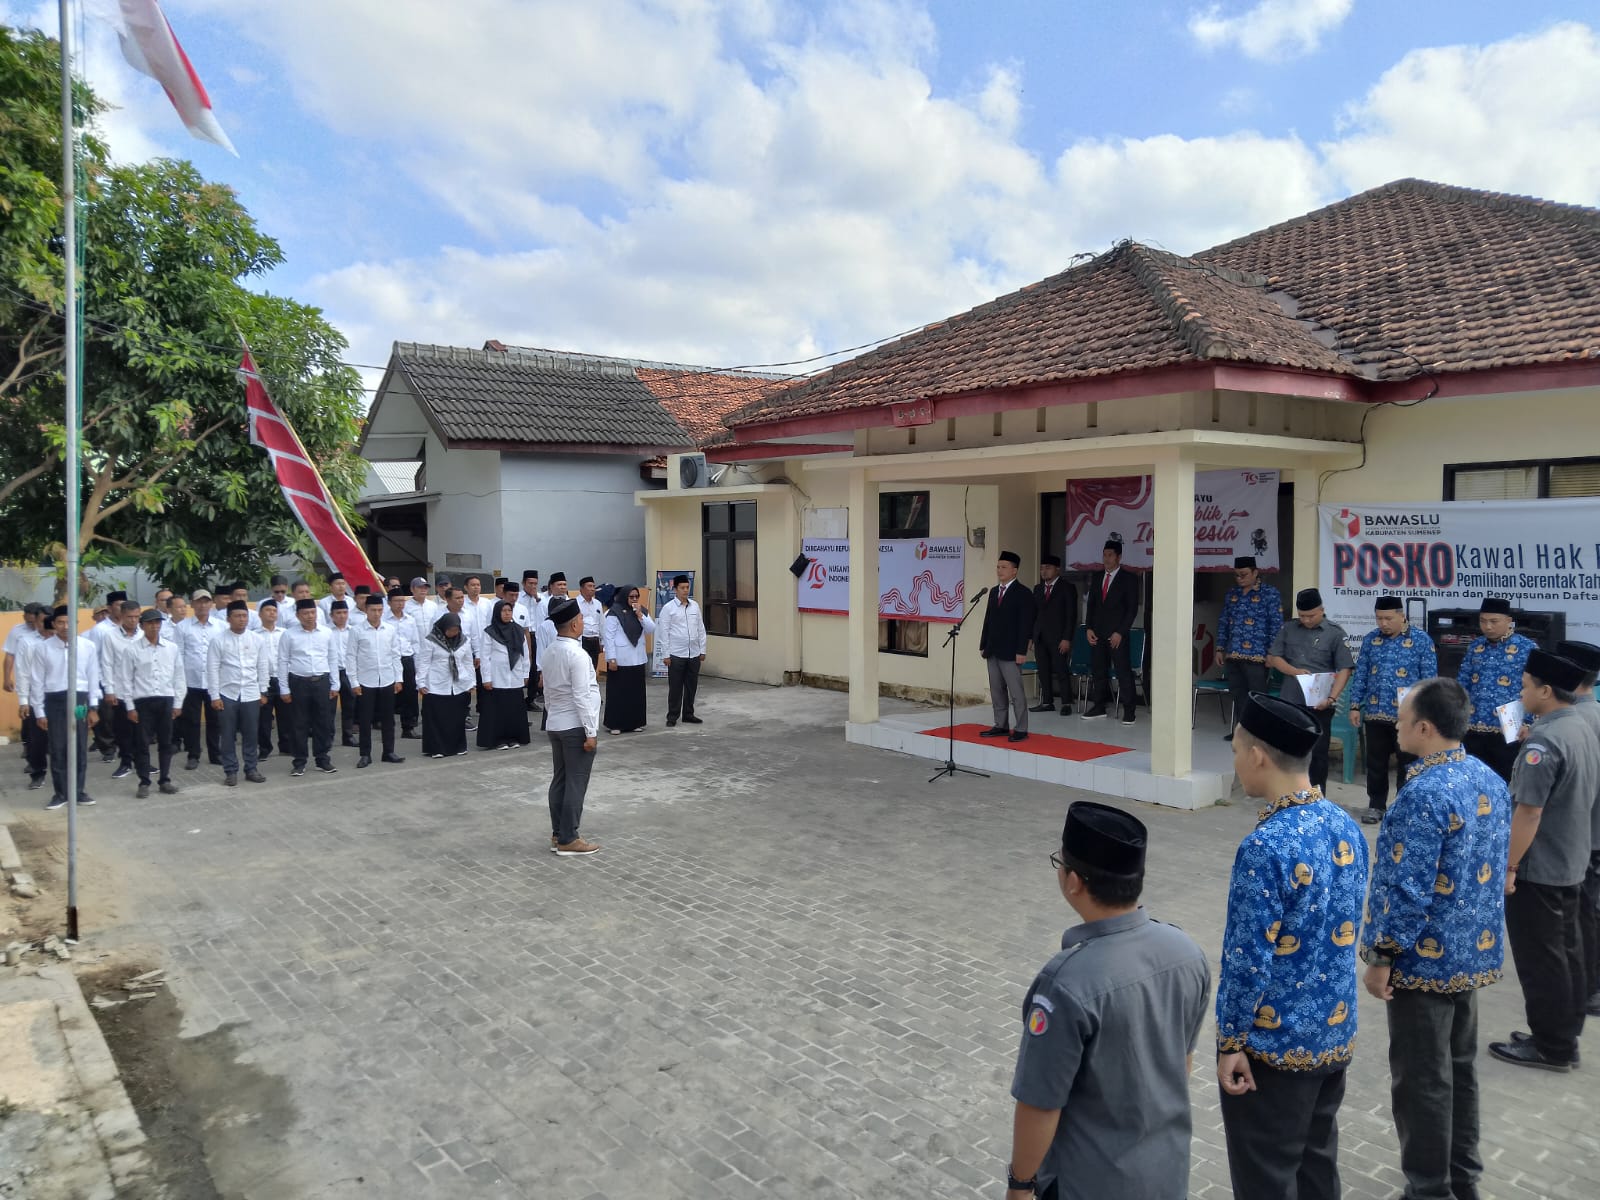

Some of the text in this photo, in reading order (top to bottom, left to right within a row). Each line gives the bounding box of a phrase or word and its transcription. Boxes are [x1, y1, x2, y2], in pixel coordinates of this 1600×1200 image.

[1364, 514, 1440, 526] BAWASLU
[1333, 542, 1454, 588] POSKO
[1455, 544, 1524, 569] Kawal
[1536, 544, 1583, 569] Hak
[1457, 572, 1600, 589] Pemilihan Serentak Tah
[1334, 588, 1599, 601] Tahapan Pemuktahiran dan Penyusunan Dafta
